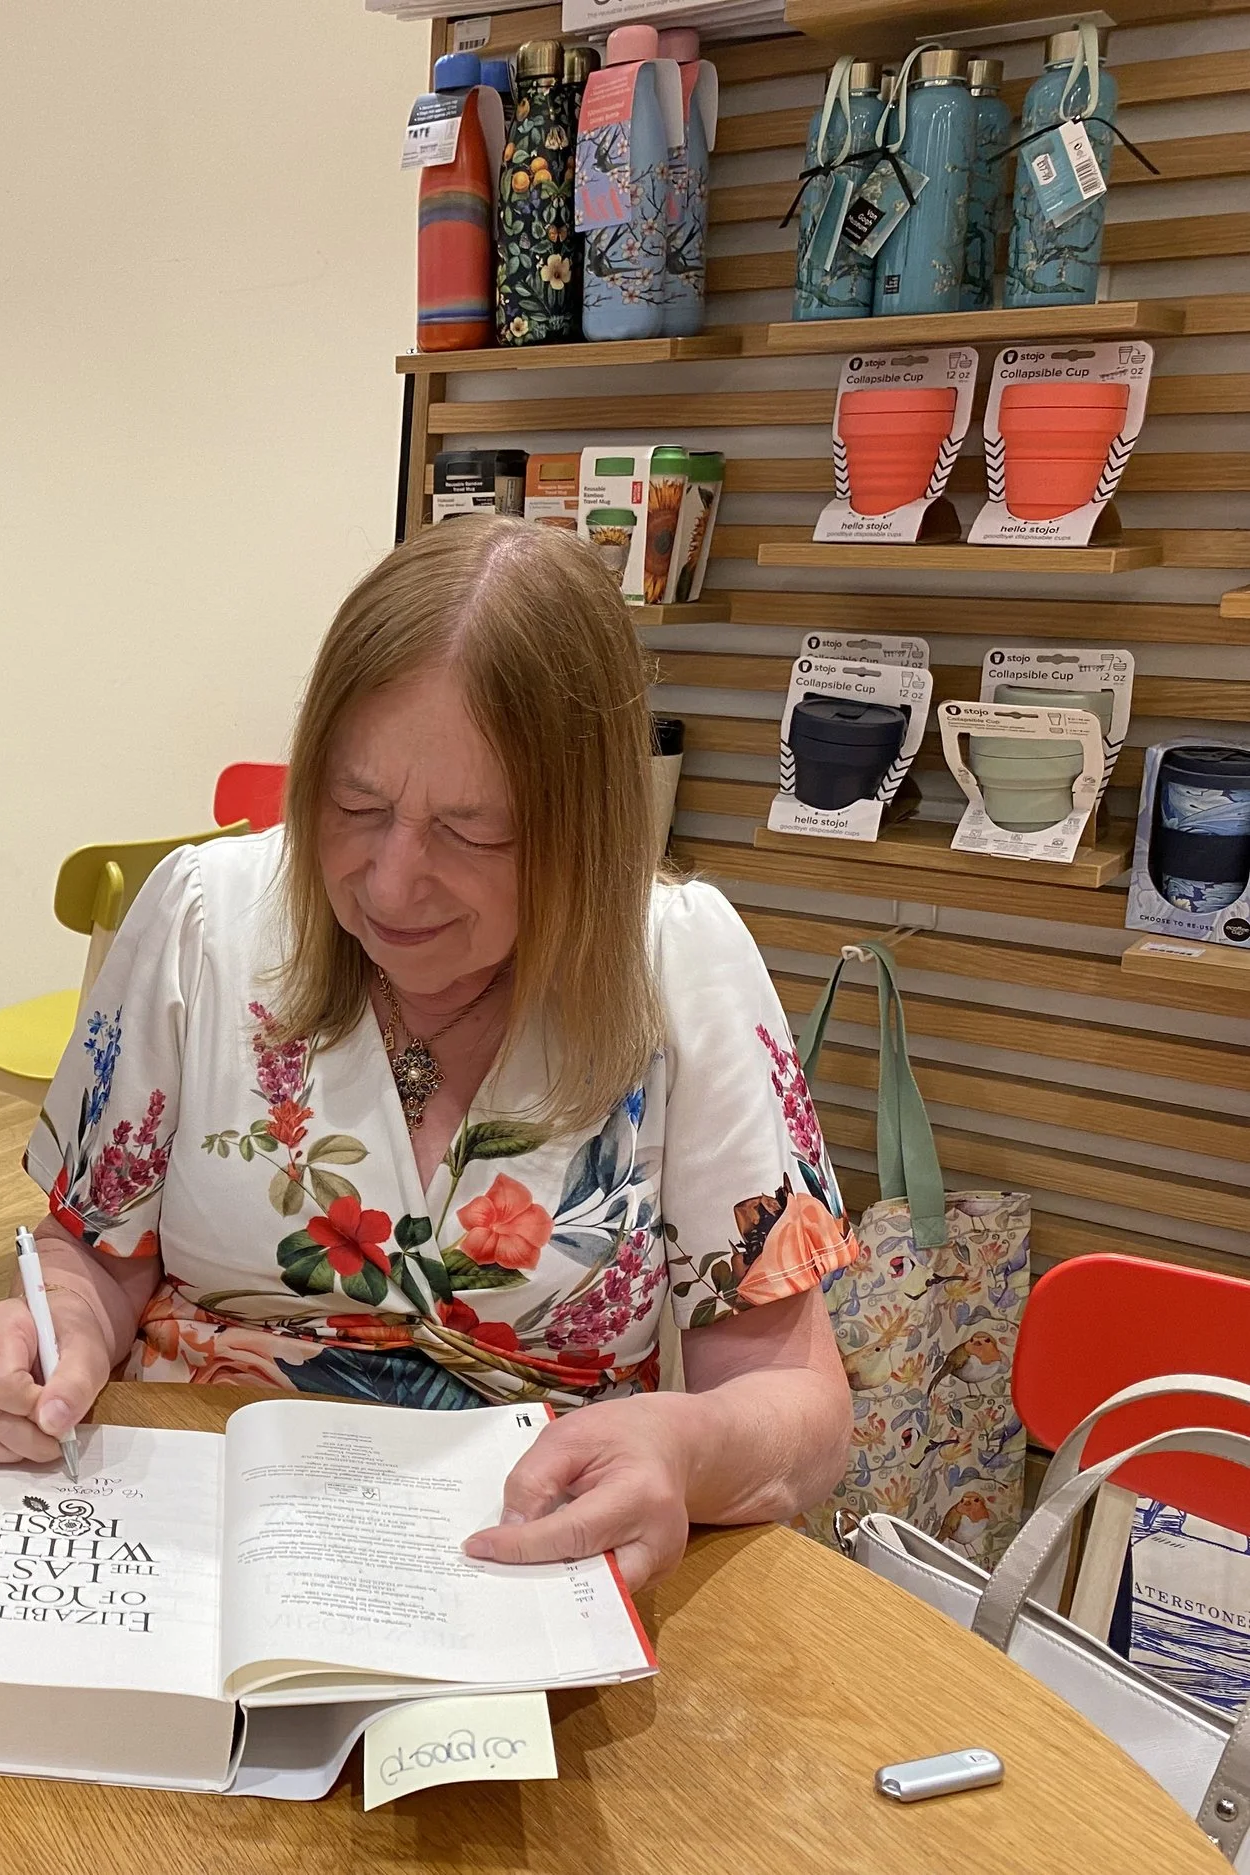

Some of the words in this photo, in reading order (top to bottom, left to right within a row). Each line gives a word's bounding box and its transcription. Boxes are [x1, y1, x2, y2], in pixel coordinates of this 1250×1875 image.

[408, 127, 431, 139] TATE
[857, 213, 873, 226] Gogh
[866, 209, 878, 221] Van
[847, 214, 868, 233] Museum
[1021, 352, 1045, 363] stojo
[864, 359, 887, 370] stojo
[846, 375, 901, 385] Collapsible
[903, 372, 924, 384] Cup
[946, 371, 956, 379] 12
[958, 371, 970, 379] oz
[1000, 368, 1062, 380] Collapsible
[1065, 367, 1090, 379] Cup
[841, 522, 864, 530] hello
[865, 522, 892, 532] stojo!
[1000, 525, 1027, 533] hello
[1029, 526, 1060, 535] stojo!
[853, 530, 886, 538] disposable
[1014, 533, 1053, 541] disposable
[822, 640, 843, 650] stojo
[1007, 654, 1031, 665] stojo
[814, 664, 837, 675] stojo
[988, 669, 1049, 681] Collapsible
[1051, 671, 1074, 681] Cup
[1113, 674, 1126, 682] oz
[795, 677, 852, 691] Collapsible
[854, 683, 876, 695] Cup
[899, 689, 909, 698] 12
[963, 708, 989, 717] stojo
[794, 815, 819, 825] hello
[820, 819, 848, 829] stojo!
[779, 823, 808, 832] goodbye
[808, 826, 844, 835] disposable
[1139, 914, 1171, 925] CHOOSE
[1173, 919, 1184, 927] TO
[1186, 922, 1215, 932] RE-USE
[52, 1486, 114, 1497] Georgia
[109, 1564, 161, 1577] THE
[99, 1590, 147, 1606] OF
[1134, 1581, 1250, 1629] ATERSTONE
